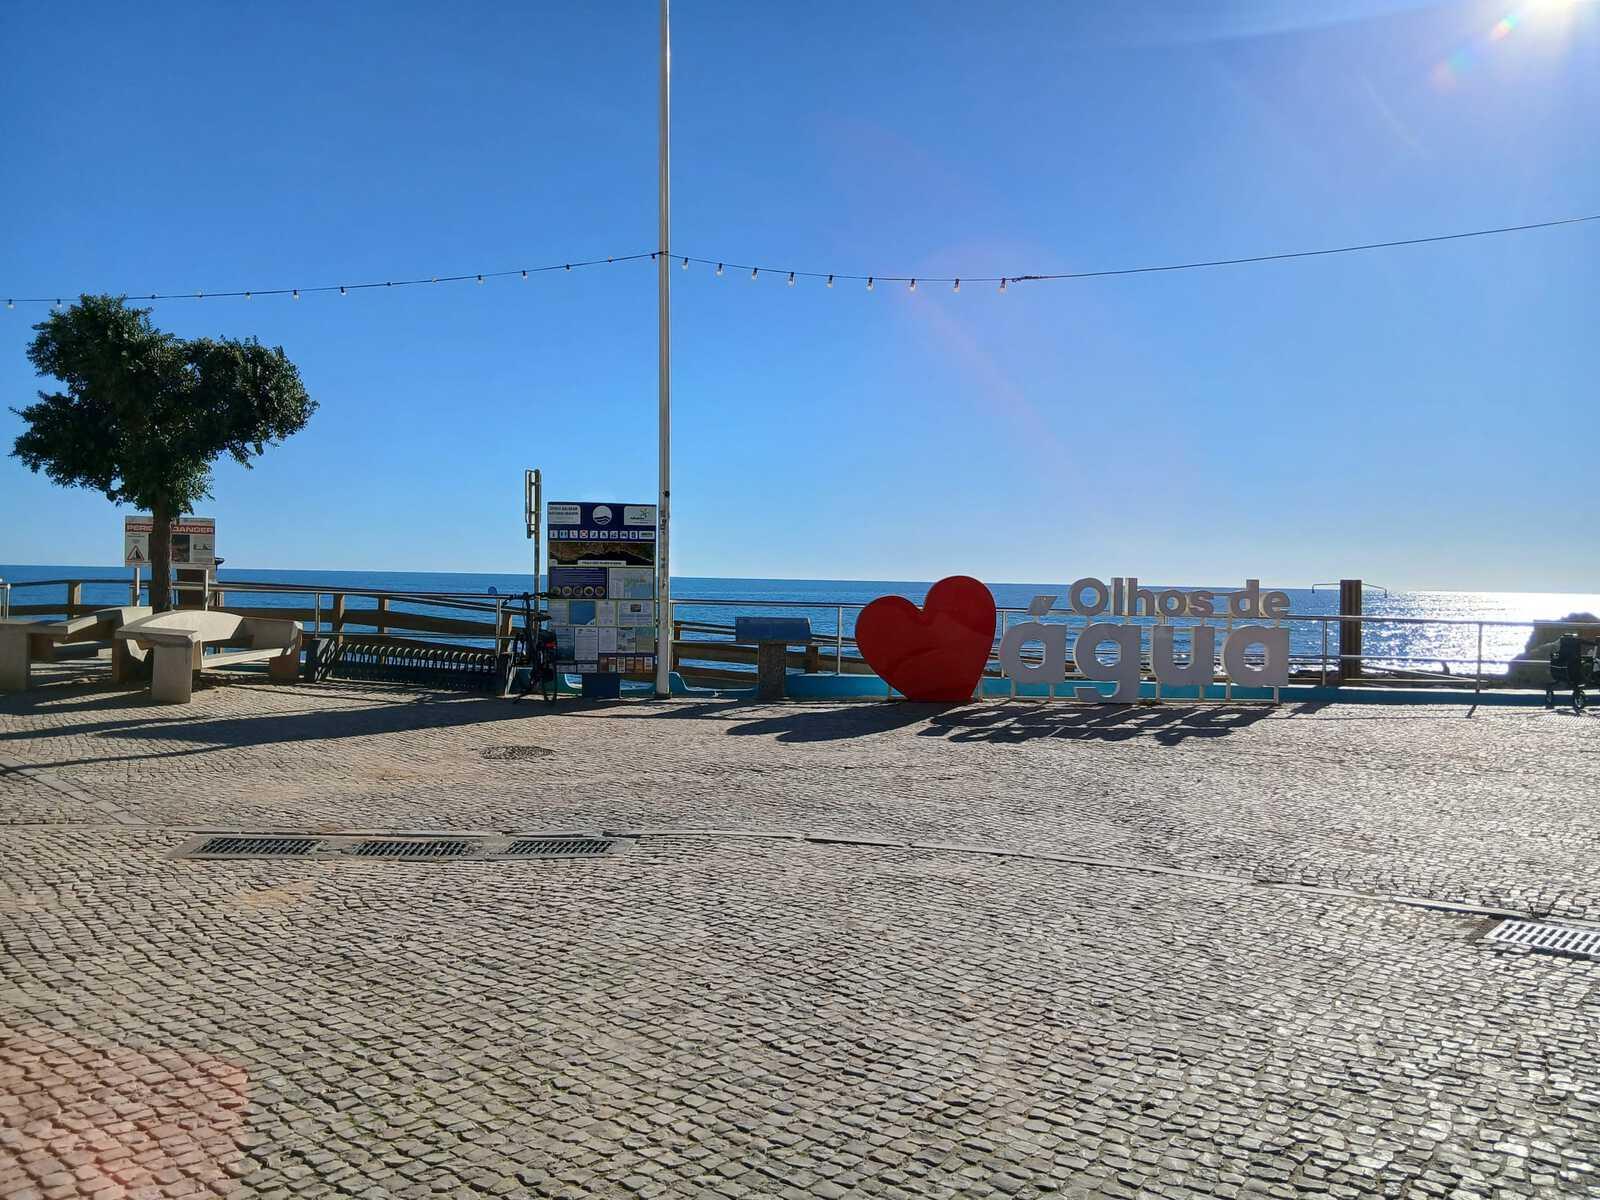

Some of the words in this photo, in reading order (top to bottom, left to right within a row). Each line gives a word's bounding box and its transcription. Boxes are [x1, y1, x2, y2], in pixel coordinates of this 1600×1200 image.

[1069, 577, 1214, 617] Olhos
[1230, 579, 1290, 618] de
[999, 595, 1290, 702] água
